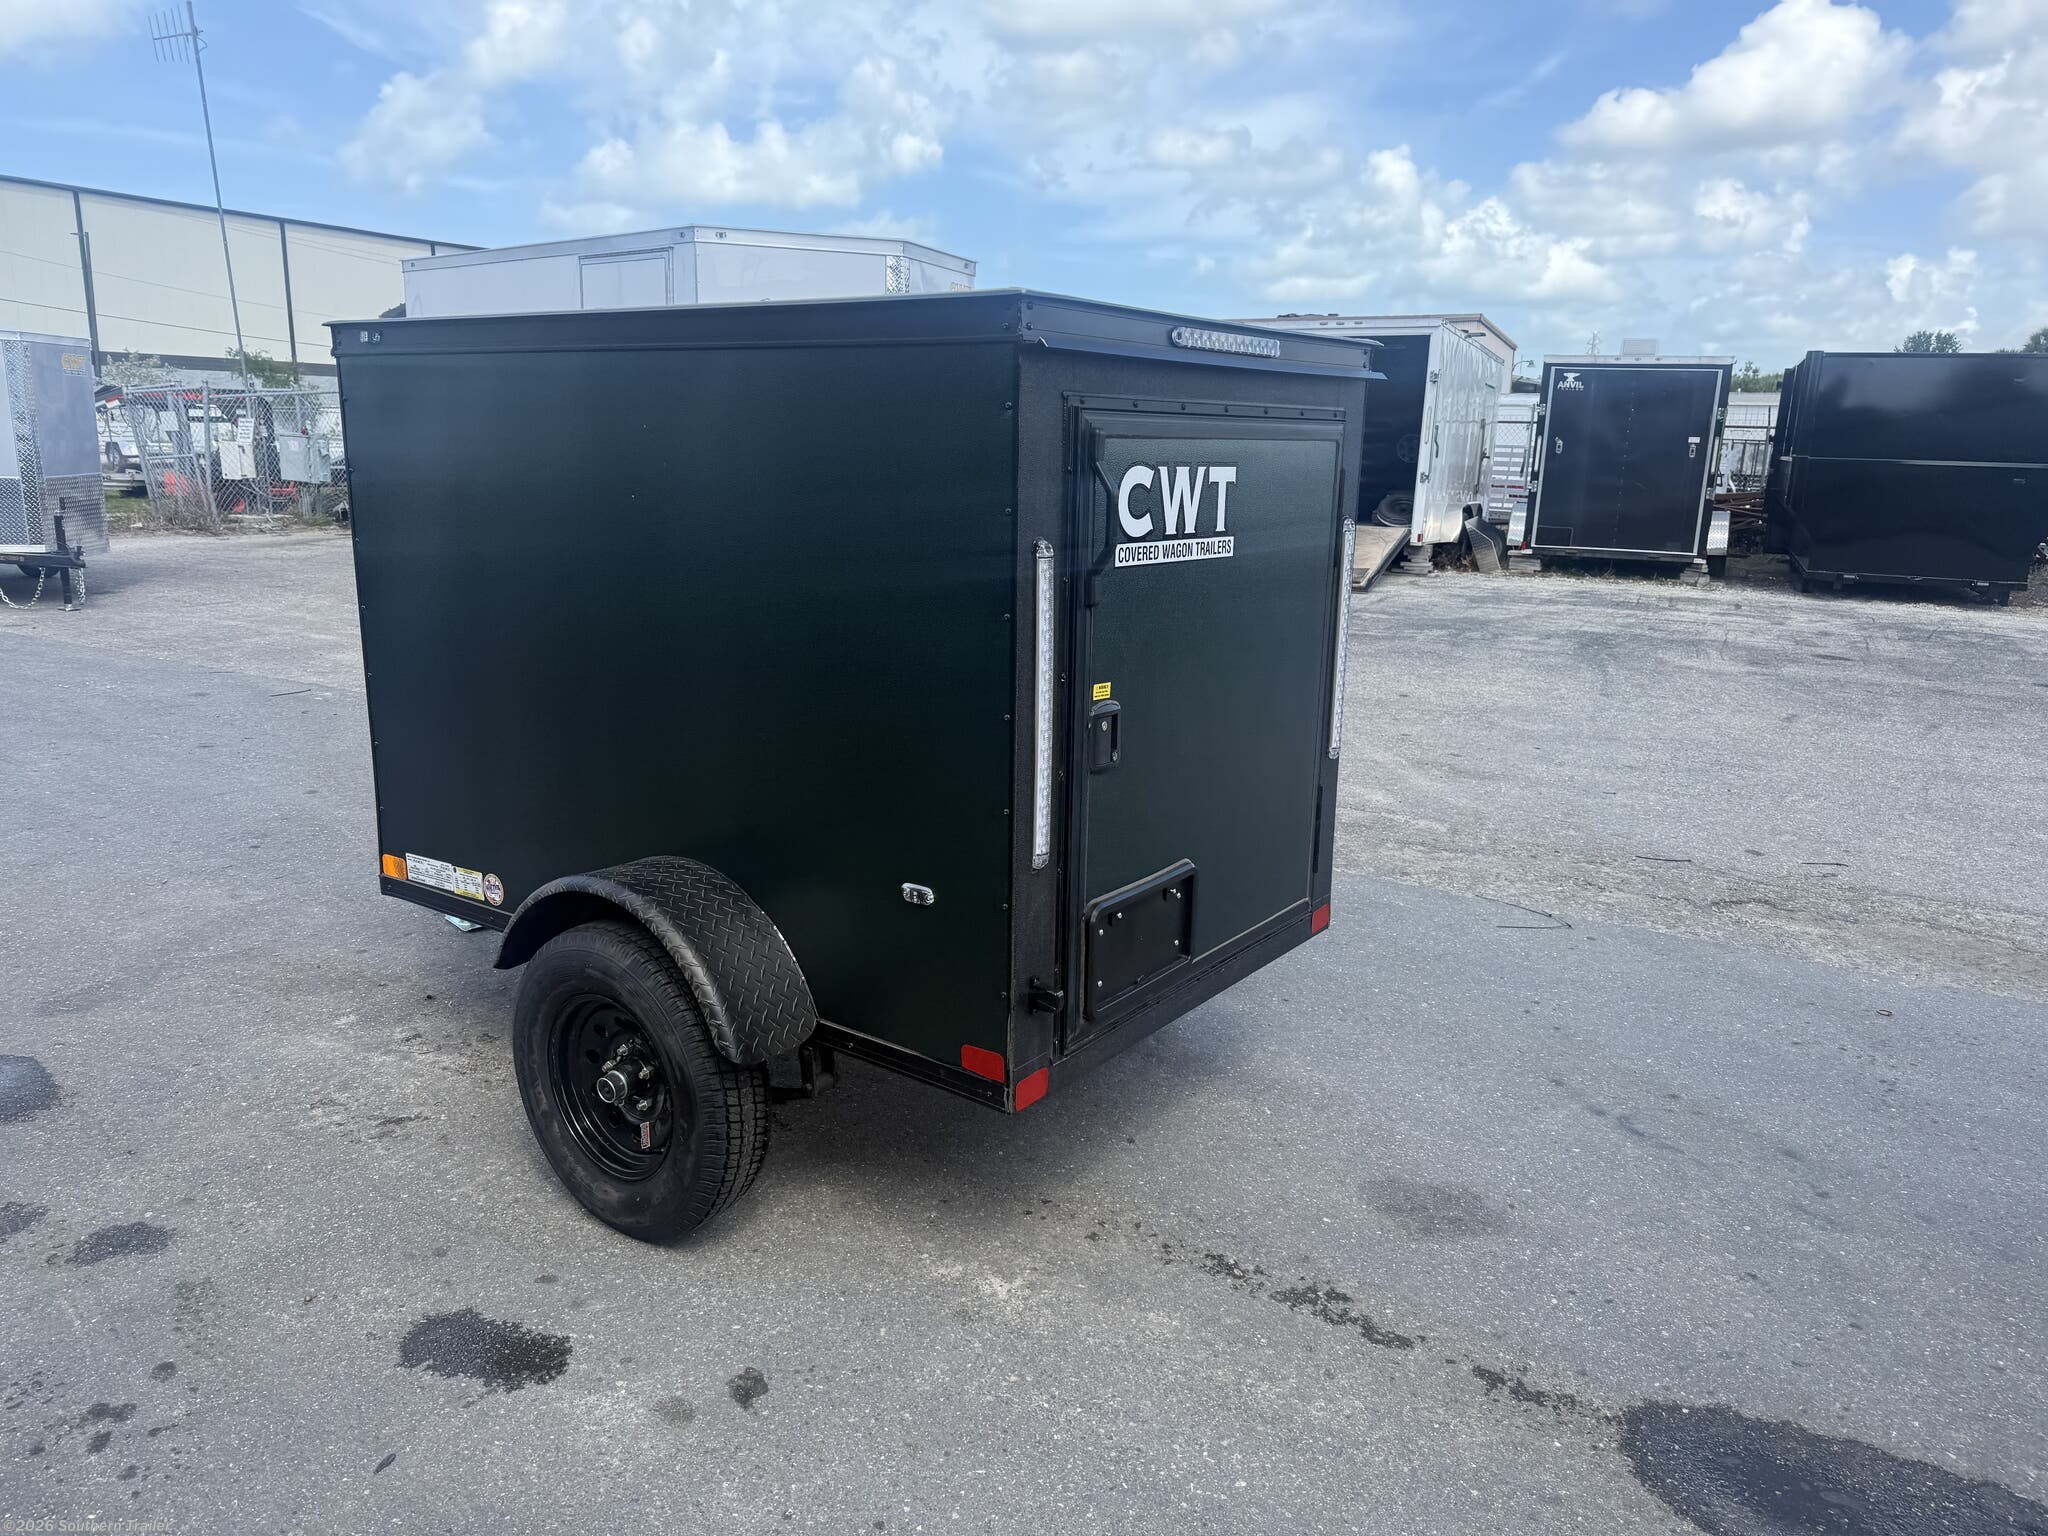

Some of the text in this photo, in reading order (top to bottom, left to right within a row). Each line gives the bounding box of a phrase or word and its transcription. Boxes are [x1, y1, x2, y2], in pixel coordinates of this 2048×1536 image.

[1557, 381, 1585, 389] ANVIL
[1118, 465, 1237, 538] CWT
[1118, 539, 1232, 563] COVERED WAGON TRAILERS
